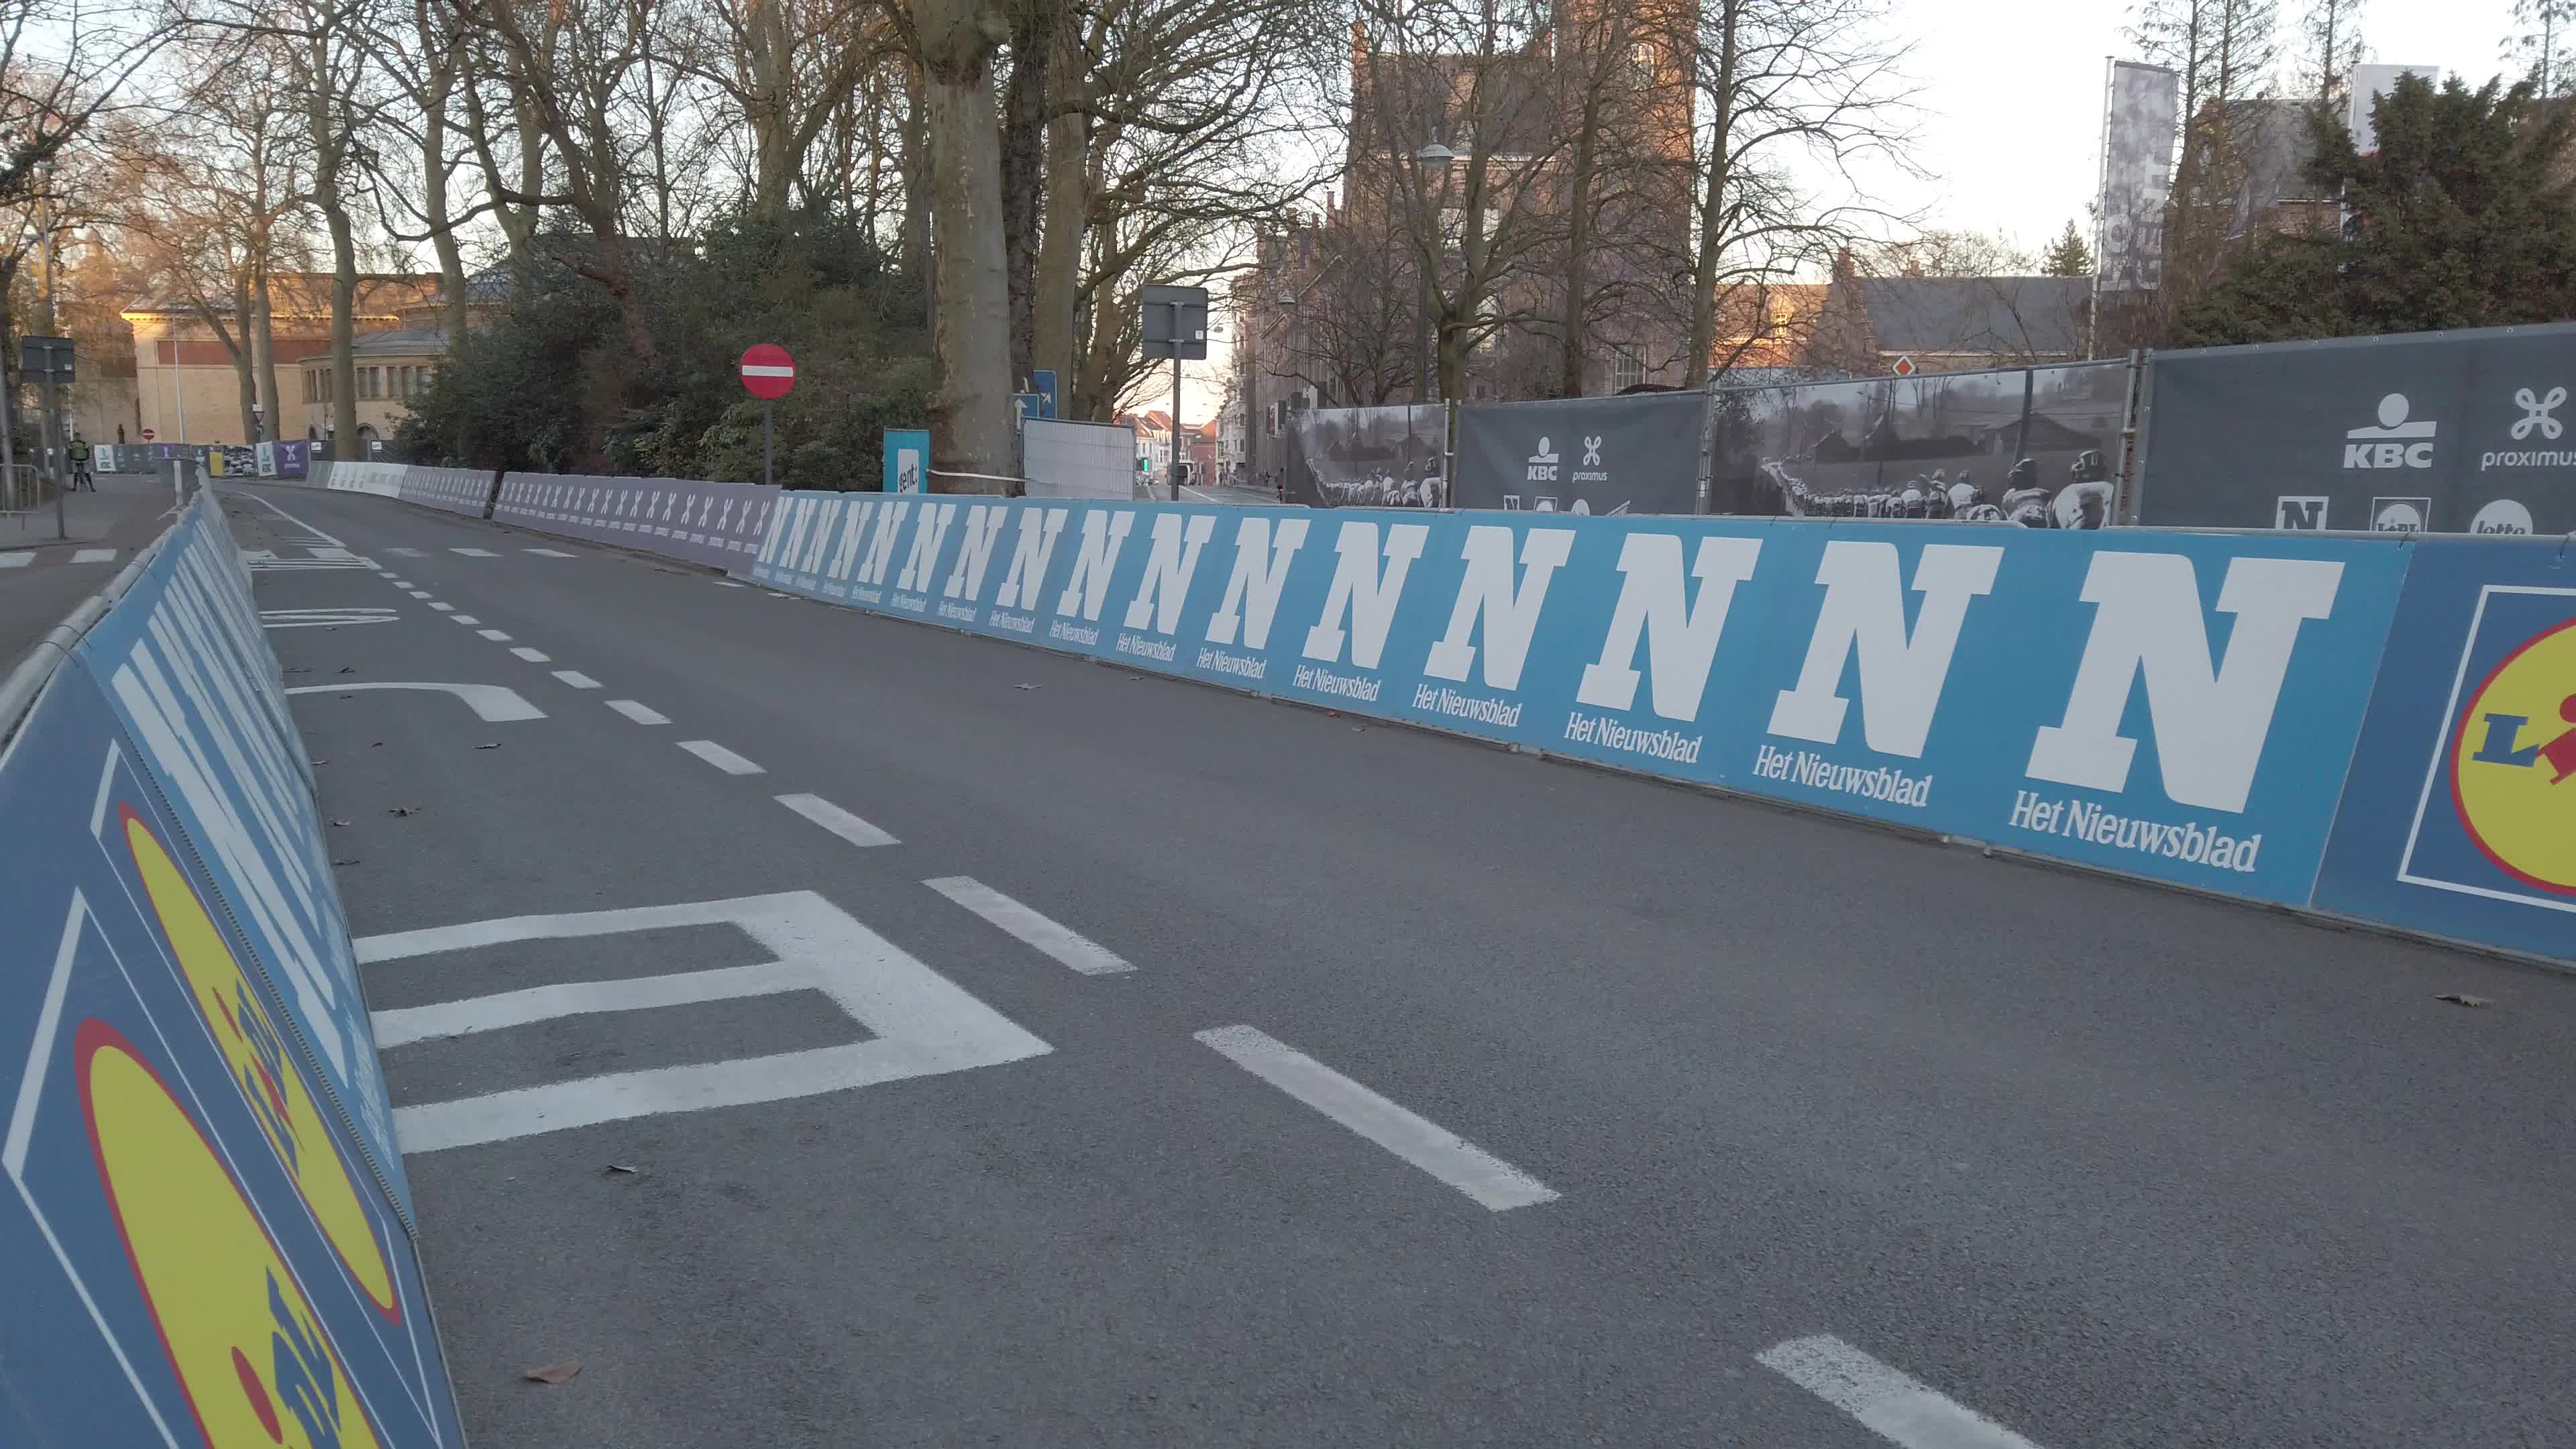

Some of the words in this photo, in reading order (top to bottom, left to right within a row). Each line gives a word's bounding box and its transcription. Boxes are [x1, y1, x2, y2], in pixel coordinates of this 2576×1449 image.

[1527, 466, 1558, 481] KBC
[1572, 472, 1608, 483] proximus
[2343, 442, 2434, 468] KBC
[800, 500, 843, 574] N
[826, 501, 874, 580] N
[857, 502, 910, 585] N
[897, 502, 957, 592] N
[944, 505, 1008, 601] N
[2282, 501, 2324, 529] N
[996, 508, 1068, 610] N
[1057, 510, 1136, 621] N
[1124, 513, 1217, 635] N
[1205, 517, 1310, 649] N
[1302, 521, 1430, 669] N
[1116, 633, 1131, 653] Het
[1128, 635, 1177, 661] Nieuwsblad
[1424, 526, 1576, 690] N
[1576, 533, 1763, 722] N
[1196, 647, 1214, 669] Het
[1211, 650, 1267, 679] Nieuwsblad
[1292, 664, 1315, 689] Het
[1311, 668, 1381, 702] Nieuwsblad
[1767, 541, 2004, 758] N
[2025, 551, 2345, 813] N
[1411, 684, 1439, 710] Het
[1435, 688, 1522, 727] Nieuwsblad
[1564, 712, 1597, 743] Het
[1593, 717, 1703, 763] Nieuwsblad
[1752, 745, 1793, 780] Het
[1790, 751, 1933, 807] Nieuwsblad
[2008, 790, 2064, 833] Het
[2061, 800, 2262, 872] Nieuwsblad
